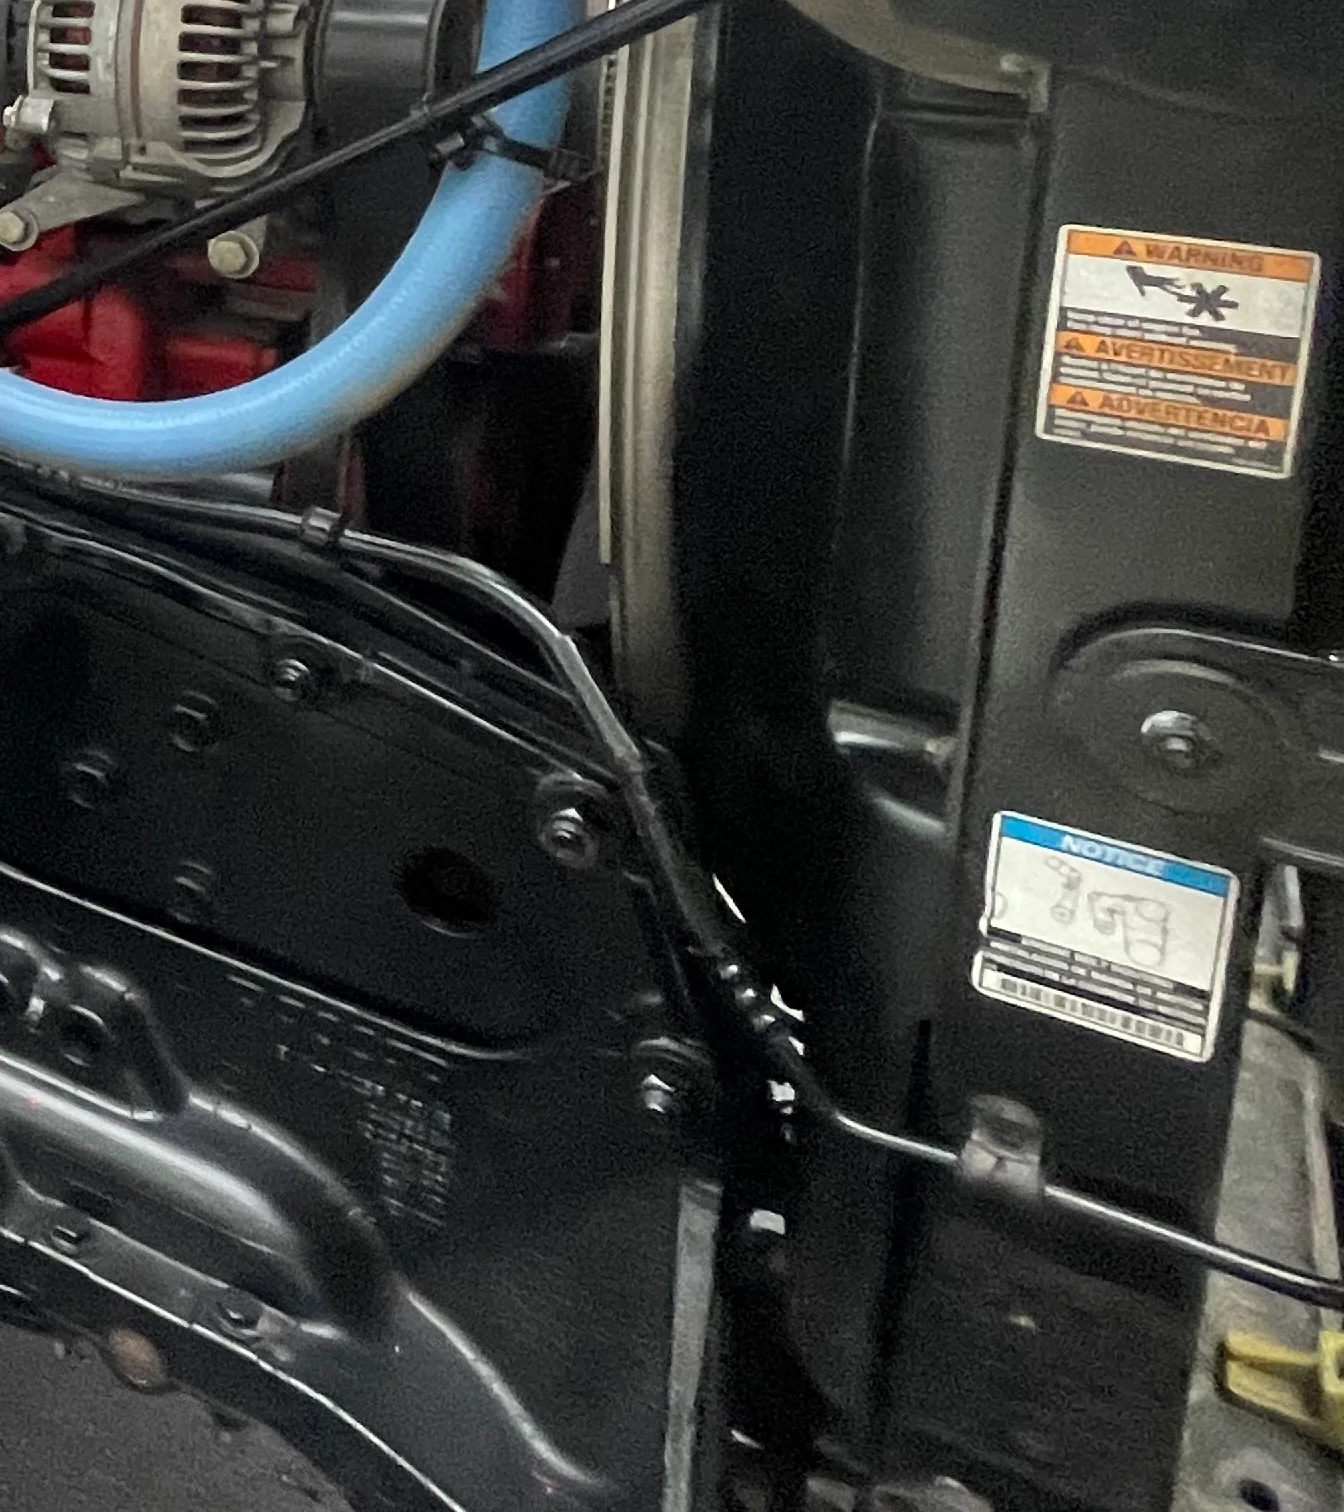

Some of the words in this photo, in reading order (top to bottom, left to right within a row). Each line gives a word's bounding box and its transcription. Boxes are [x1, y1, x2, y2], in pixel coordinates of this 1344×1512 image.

[1144, 242, 1263, 273] WARNING
[1094, 339, 1290, 381] AVERTISSEMENT
[1098, 394, 1272, 437] ADVERTENCIA
[1062, 833, 1163, 876] NOTICE
